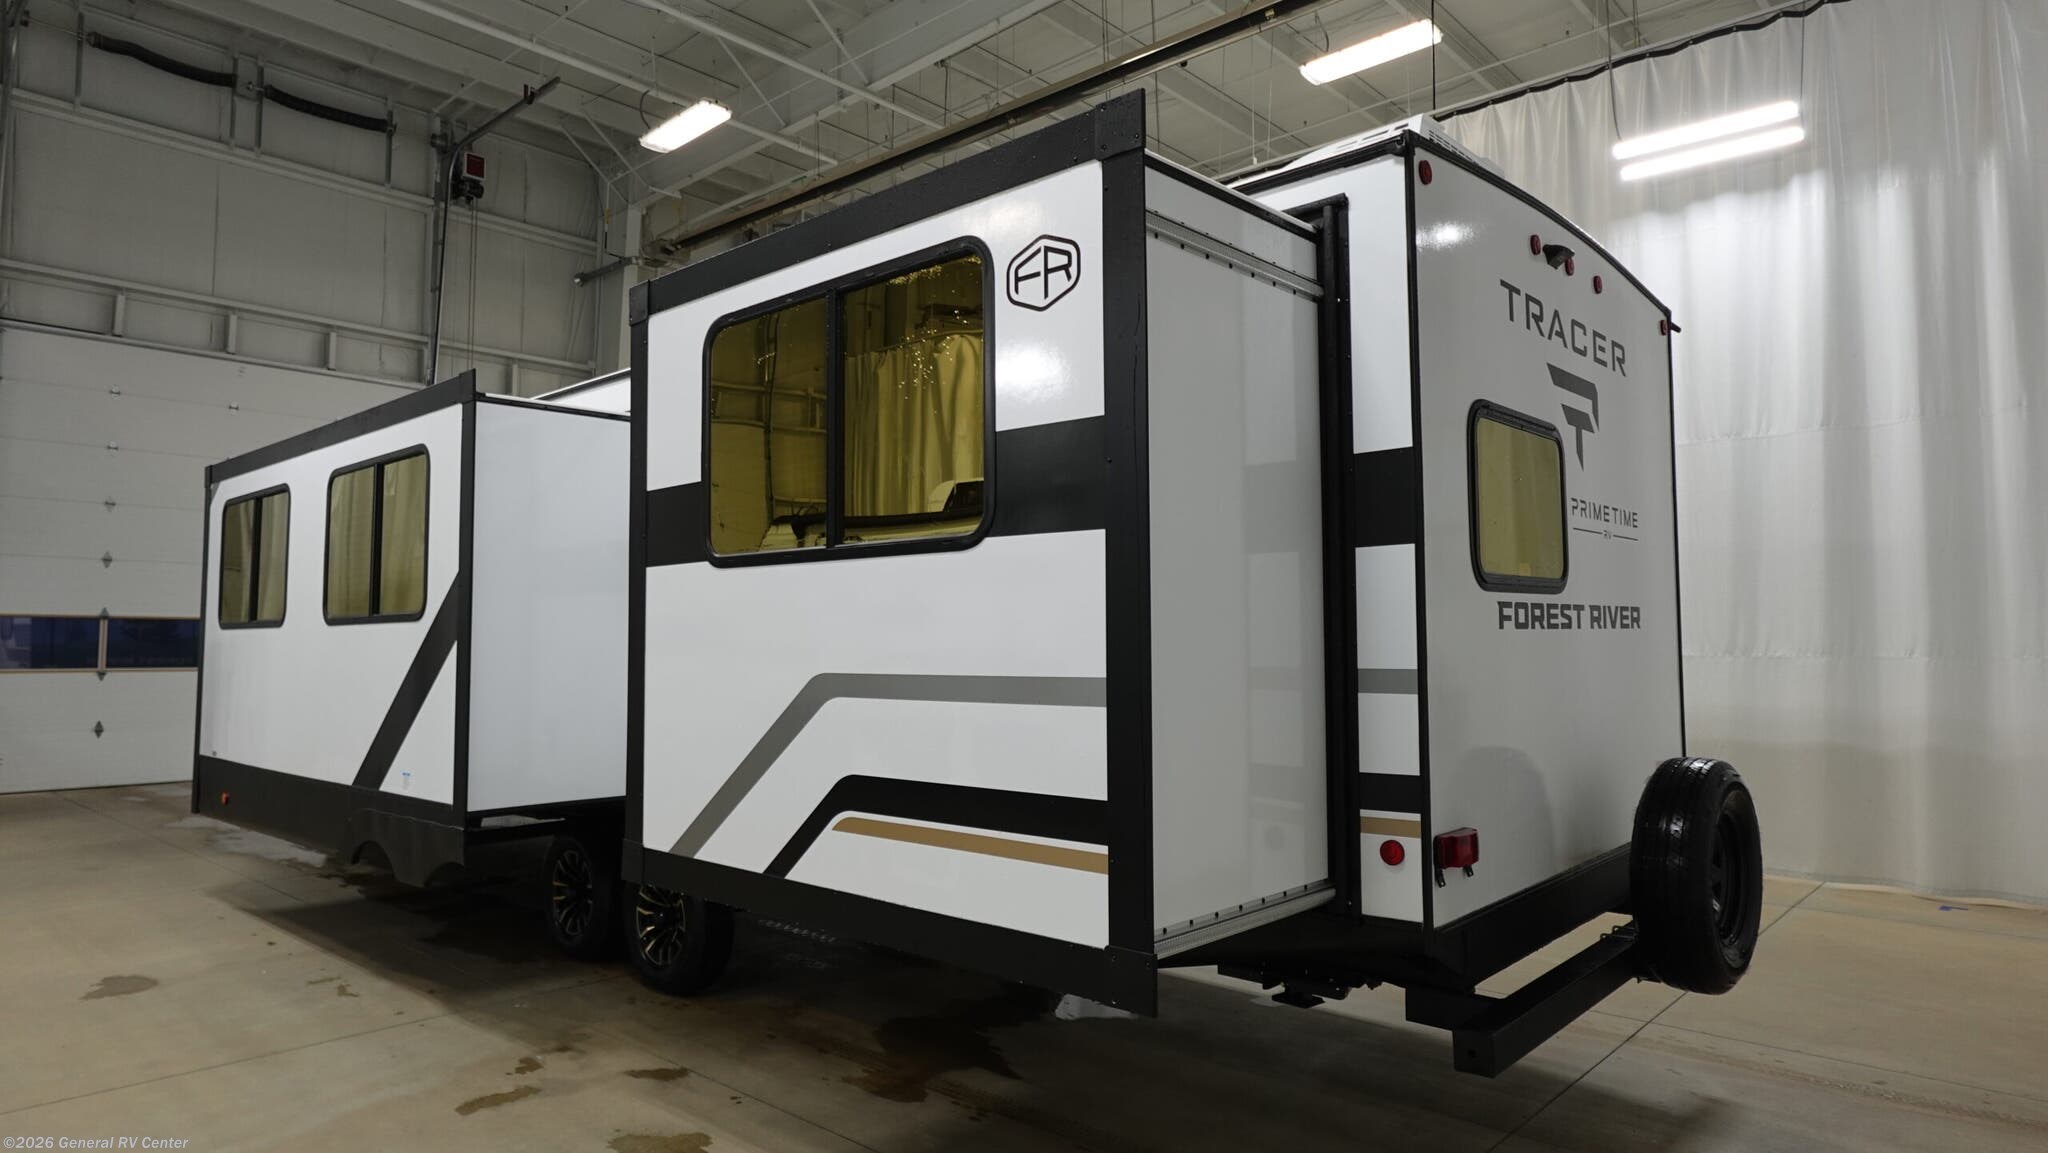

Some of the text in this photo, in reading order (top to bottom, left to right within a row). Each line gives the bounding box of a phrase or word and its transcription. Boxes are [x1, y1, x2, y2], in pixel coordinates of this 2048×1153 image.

[1500, 279, 1626, 377] TRACER
[1497, 601, 1641, 630] FOREST RIVER
